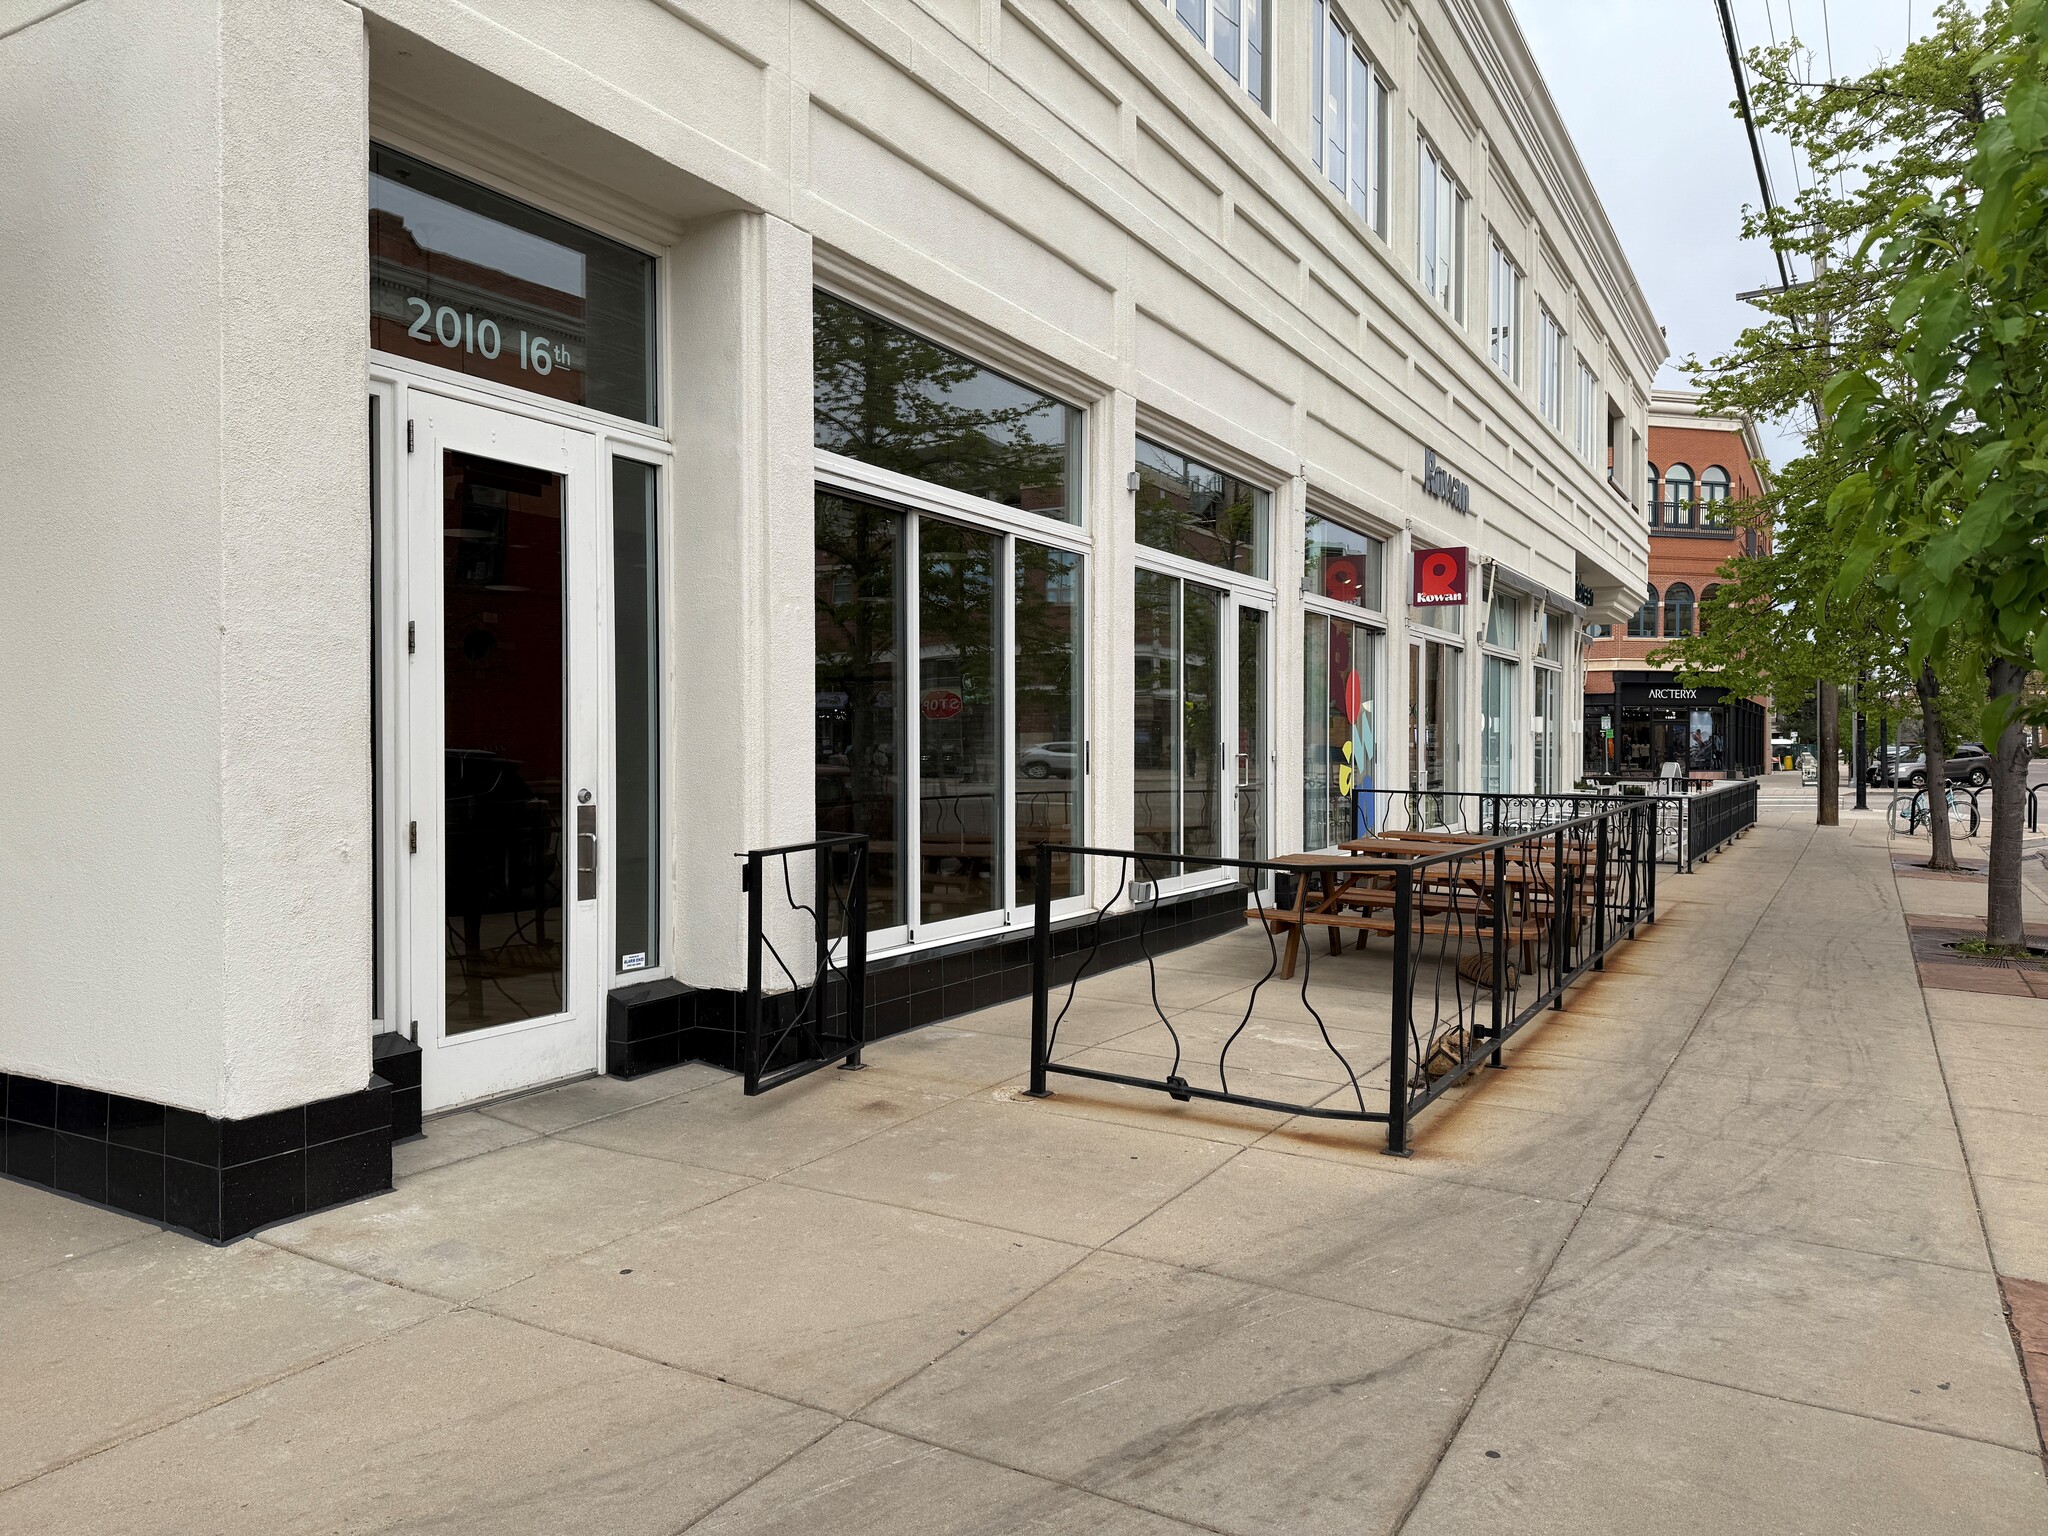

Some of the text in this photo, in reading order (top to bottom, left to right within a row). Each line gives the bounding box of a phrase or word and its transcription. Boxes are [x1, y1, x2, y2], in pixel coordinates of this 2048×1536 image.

[407, 297, 571, 376] 2010 16th
[1425, 447, 1470, 513] Rowan
[1417, 592, 1462, 603] Rowan
